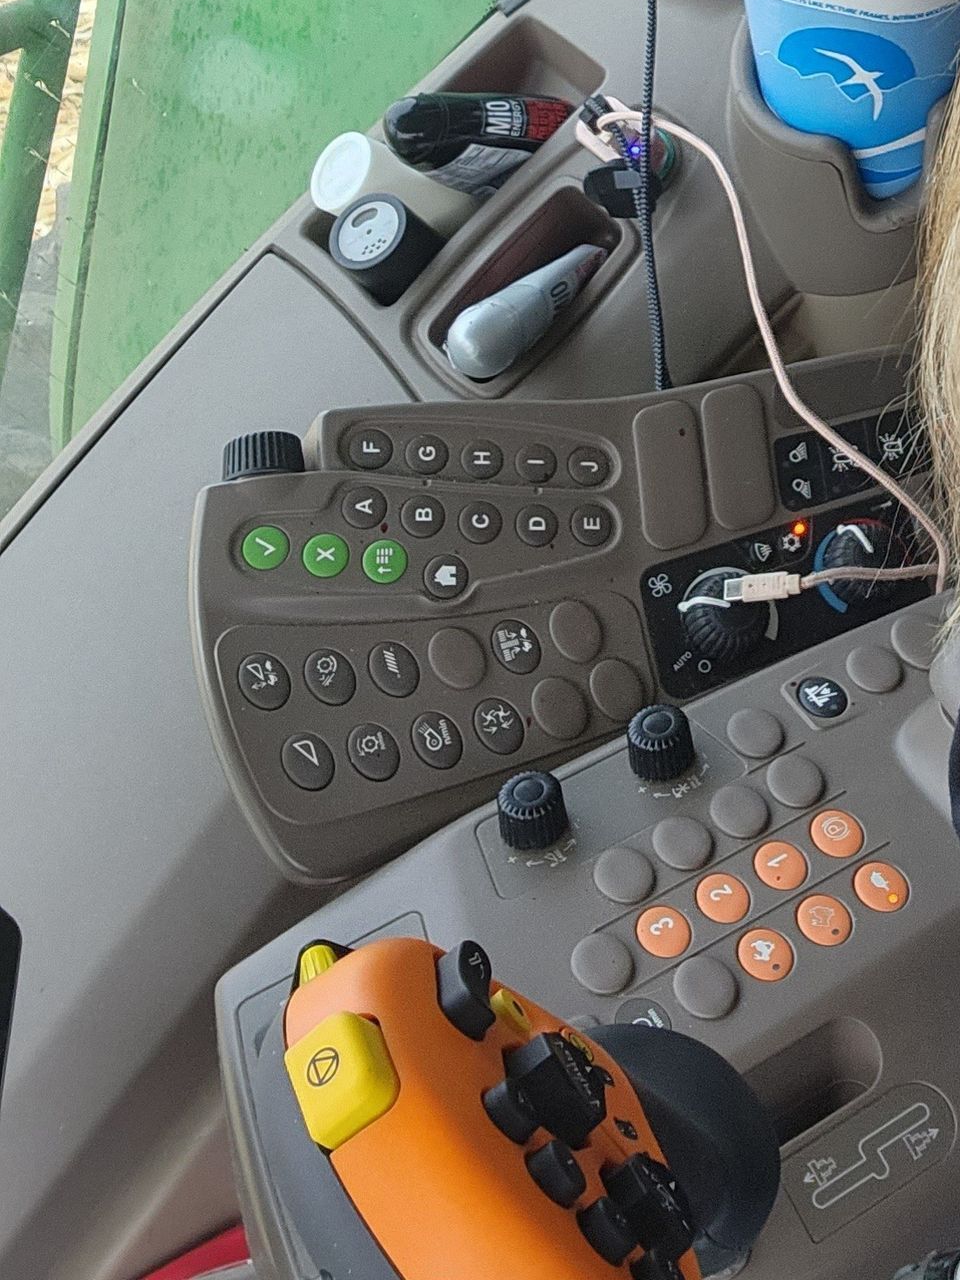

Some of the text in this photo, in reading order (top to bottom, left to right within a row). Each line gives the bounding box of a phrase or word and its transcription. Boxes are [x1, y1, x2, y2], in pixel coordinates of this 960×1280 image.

[808, 0, 824, 9] LIKE
[825, 3, 858, 14] PICTURE
[485, 100, 511, 136] MIO
[511, 100, 523, 137] ENERGY
[362, 441, 381, 453] F
[418, 445, 436, 461] G
[473, 451, 491, 465] H
[580, 461, 599, 472] J
[355, 498, 373, 514] A
[415, 507, 432, 521] B
[471, 513, 490, 529] C
[528, 516, 546, 531] D
[583, 517, 600, 530] E
[673, 651, 692, 671] AUTO
[710, 884, 733, 901] 2
[650, 917, 674, 936] 3
